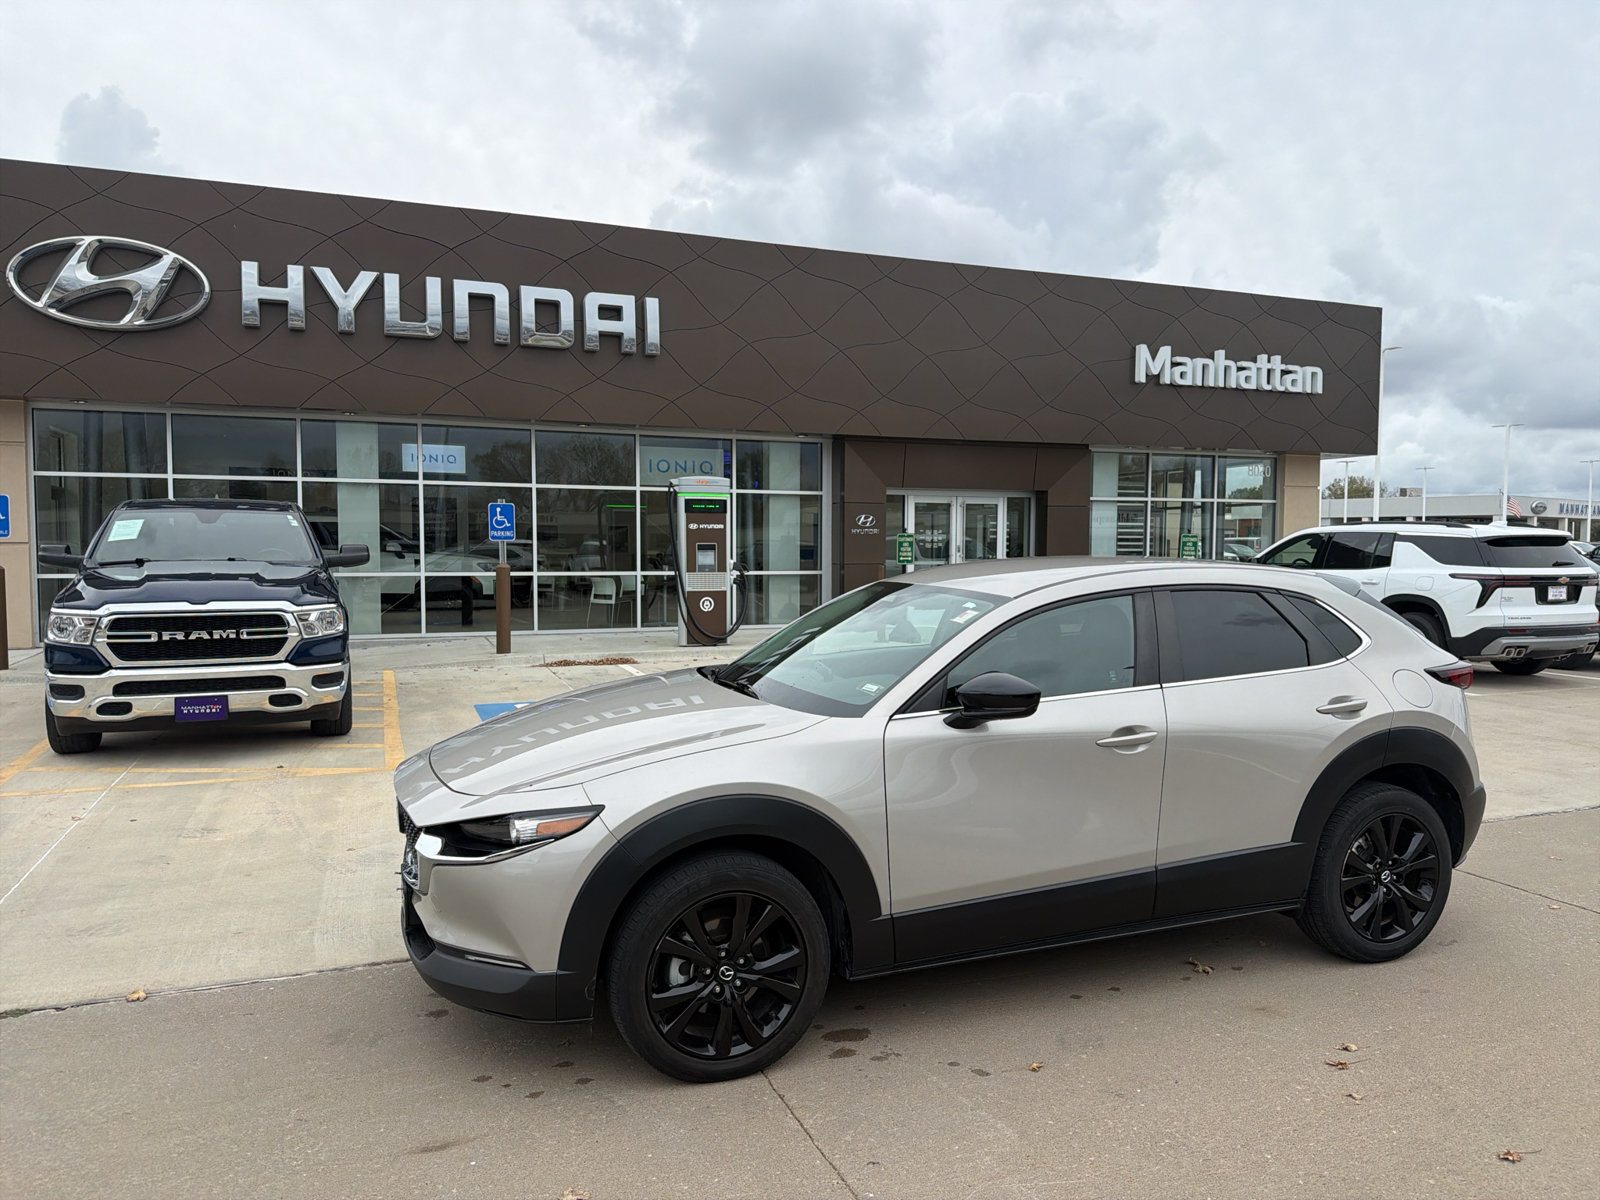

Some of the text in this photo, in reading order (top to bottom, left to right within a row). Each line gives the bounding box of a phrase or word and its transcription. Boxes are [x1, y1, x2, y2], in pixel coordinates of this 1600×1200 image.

[241, 261, 660, 356] HYUNDAI
[1135, 343, 1324, 395] Manhattan
[648, 459, 714, 475] IONIQ
[1559, 502, 1600, 516] MANHATAN
[162, 629, 237, 641] RAM
